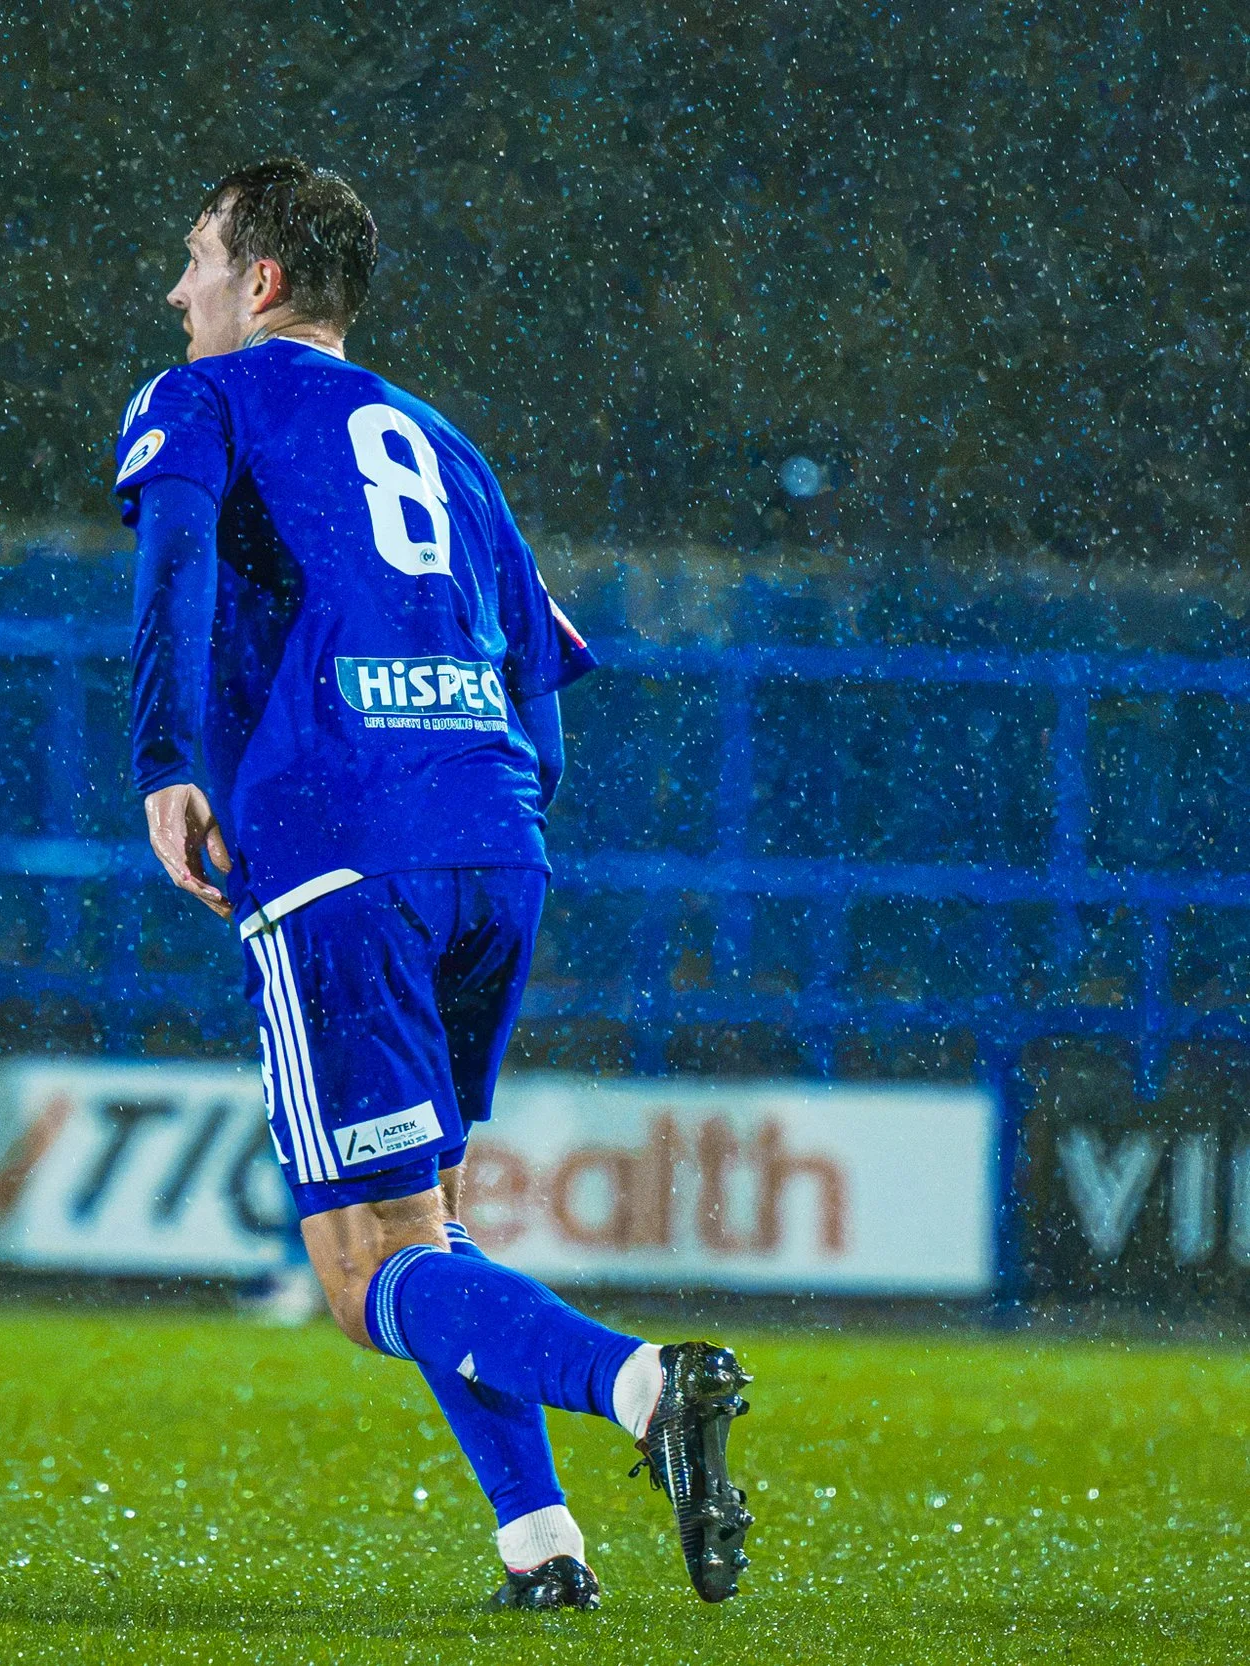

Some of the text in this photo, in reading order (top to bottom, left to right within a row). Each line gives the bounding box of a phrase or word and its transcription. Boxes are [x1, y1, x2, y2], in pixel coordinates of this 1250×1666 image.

[347, 403, 453, 577] 8
[432, 717, 473, 731] HOUSING
[383, 1120, 417, 1137] AZTEK
